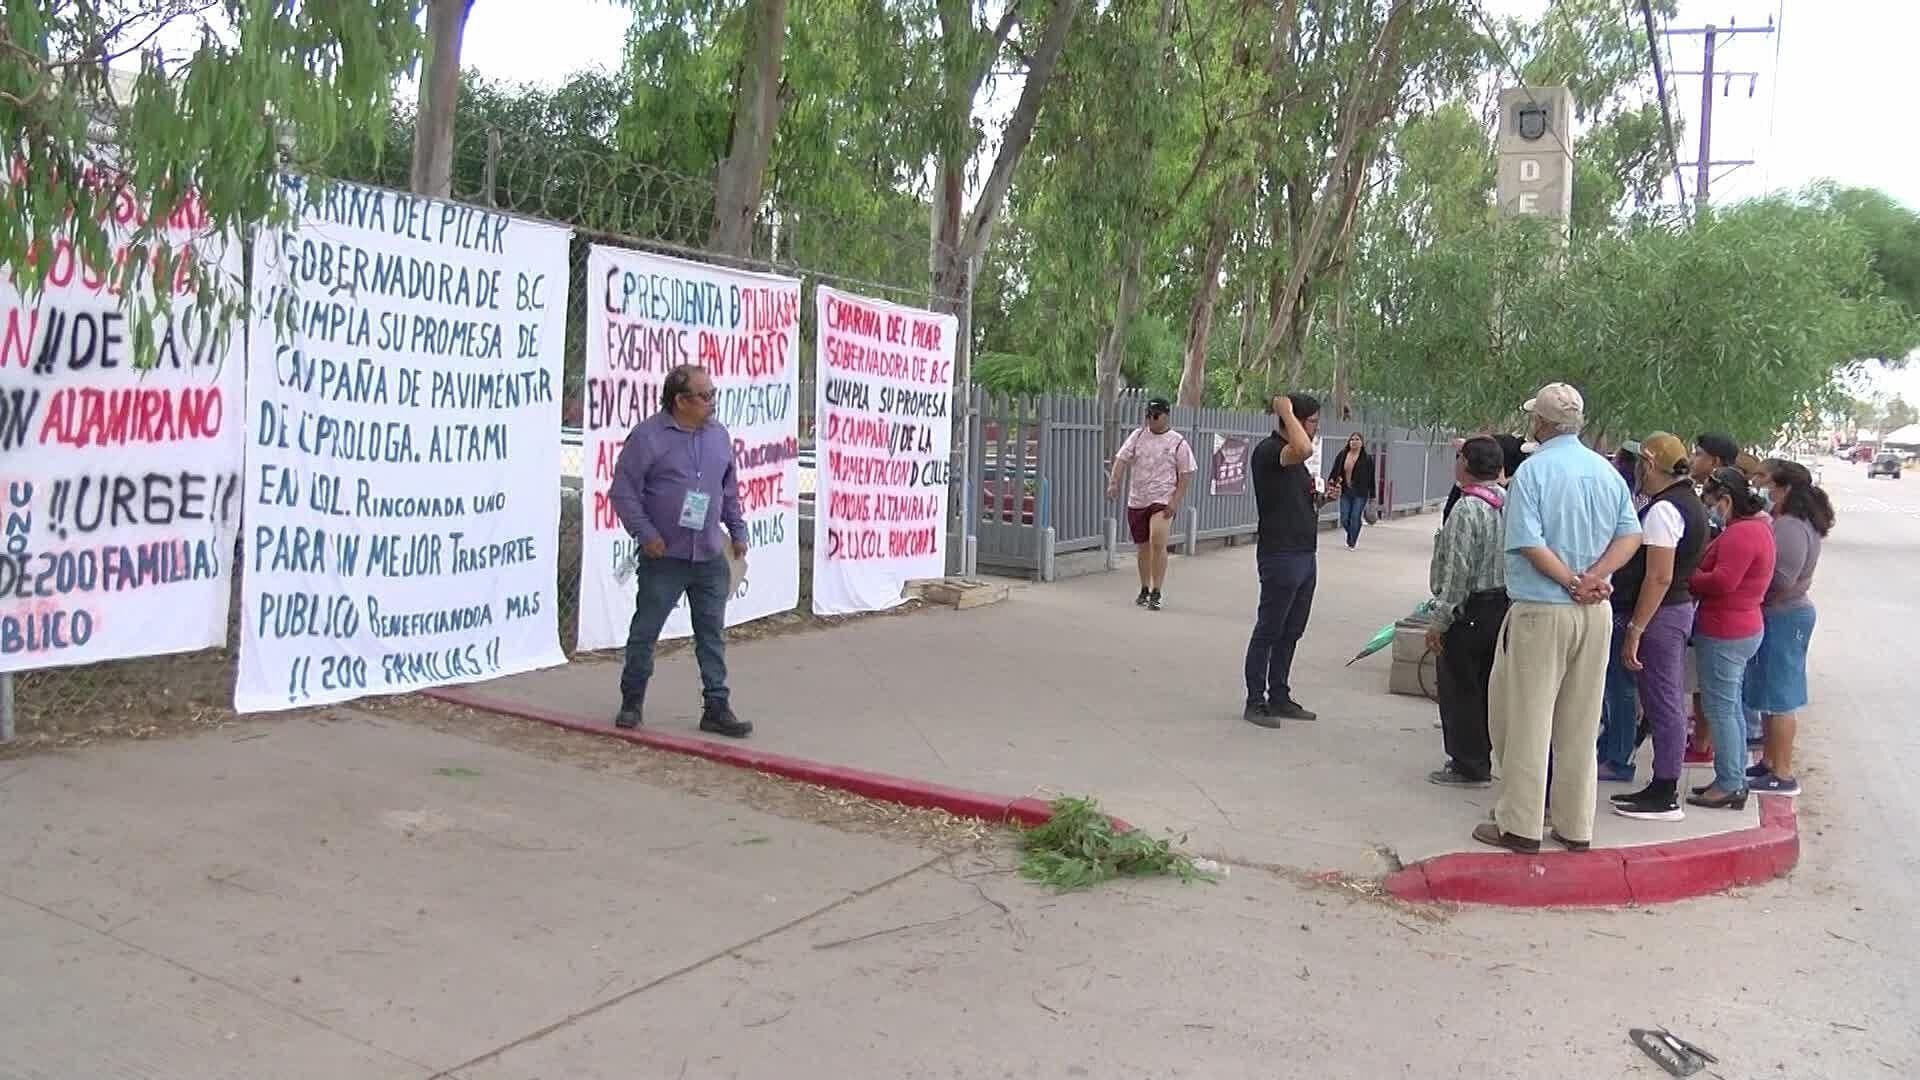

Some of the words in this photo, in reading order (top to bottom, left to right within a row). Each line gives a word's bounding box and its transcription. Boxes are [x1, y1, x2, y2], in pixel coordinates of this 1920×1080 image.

[393, 194, 432, 242] DEL
[438, 202, 510, 254] PILAR
[377, 311, 407, 352] SU
[410, 314, 502, 359] PROMESA
[516, 323, 540, 359] DE
[887, 314, 906, 346] DEL
[398, 367, 422, 408] DE
[879, 387, 895, 413] SU
[895, 389, 947, 418] PROMESA
[39, 386, 223, 448] ALTAMIRANO
[429, 423, 508, 463] ALTAMI
[258, 463, 299, 508] EN
[473, 492, 506, 515] UNO
[255, 525, 326, 574] PARA
[365, 533, 442, 578] MEJOR
[259, 591, 360, 639] PUBLICO
[505, 591, 541, 621] MAS
[321, 655, 367, 689] 200
[381, 643, 482, 685] FAMILIAS
